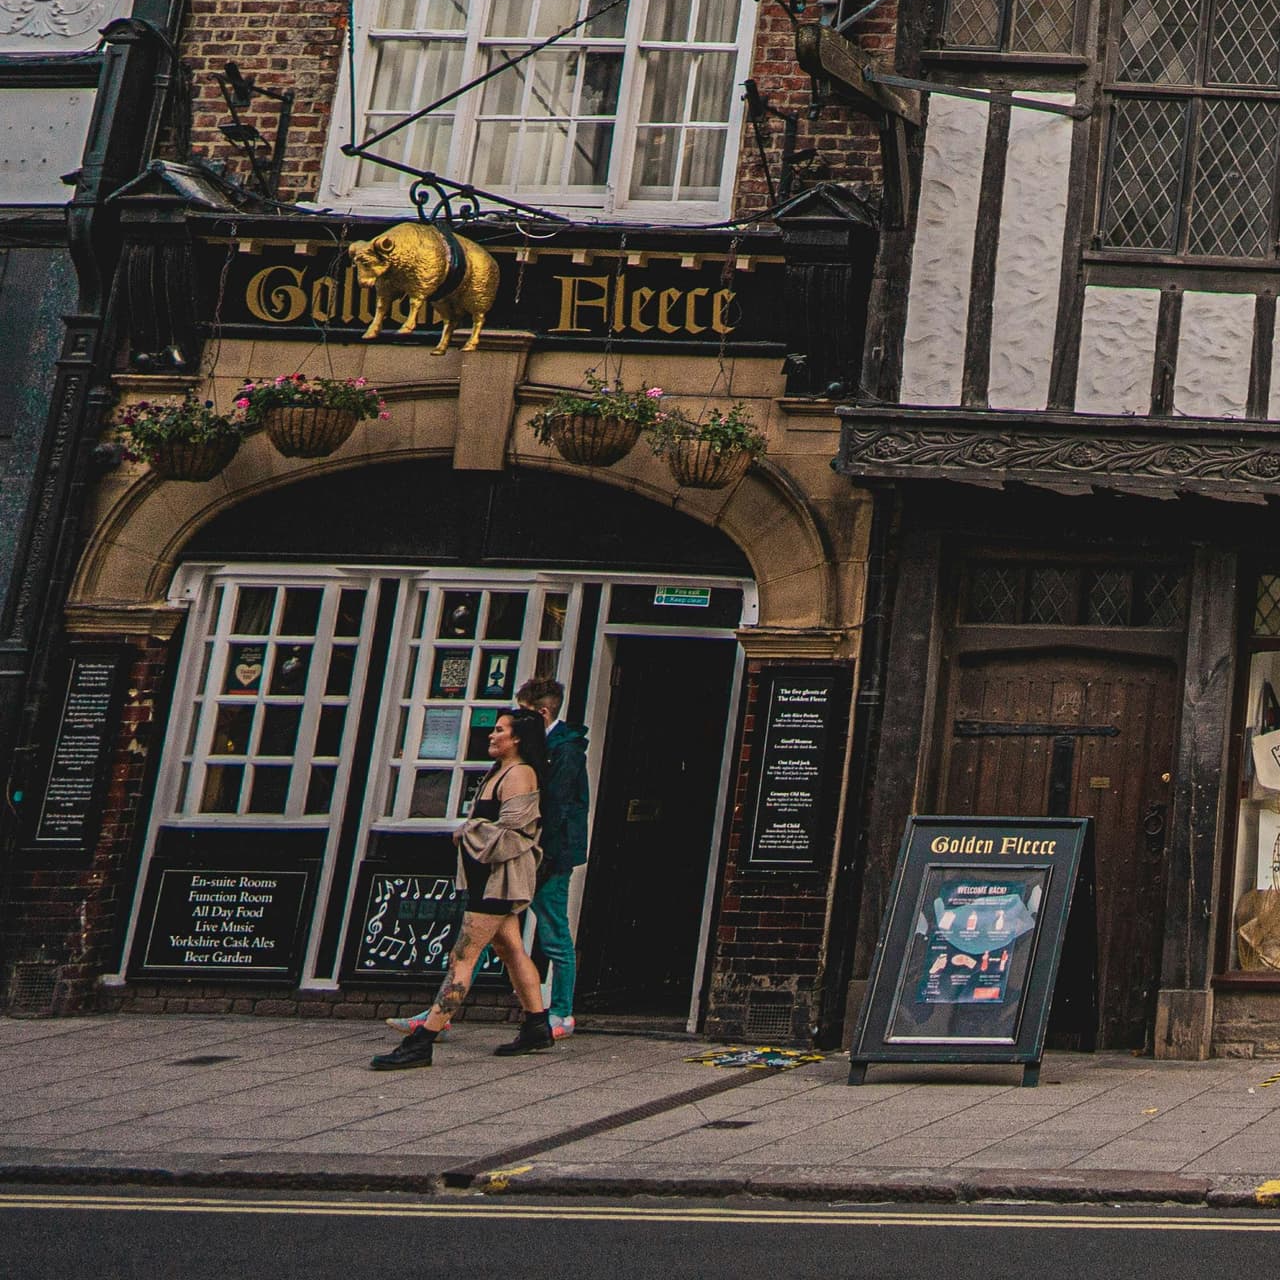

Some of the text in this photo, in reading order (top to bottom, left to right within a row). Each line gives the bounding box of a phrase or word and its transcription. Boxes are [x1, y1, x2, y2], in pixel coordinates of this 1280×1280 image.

[549, 273, 738, 334] Fleece
[931, 835, 1056, 855] Golden Fleece
[191, 875, 278, 888] En-suite Rooms
[188, 891, 273, 903] Function Room
[192, 905, 265, 920] All Day Food
[195, 921, 255, 933] Live Music
[169, 936, 275, 949] Yorkshire Cask Ales
[184, 951, 253, 964] Beer Garden
